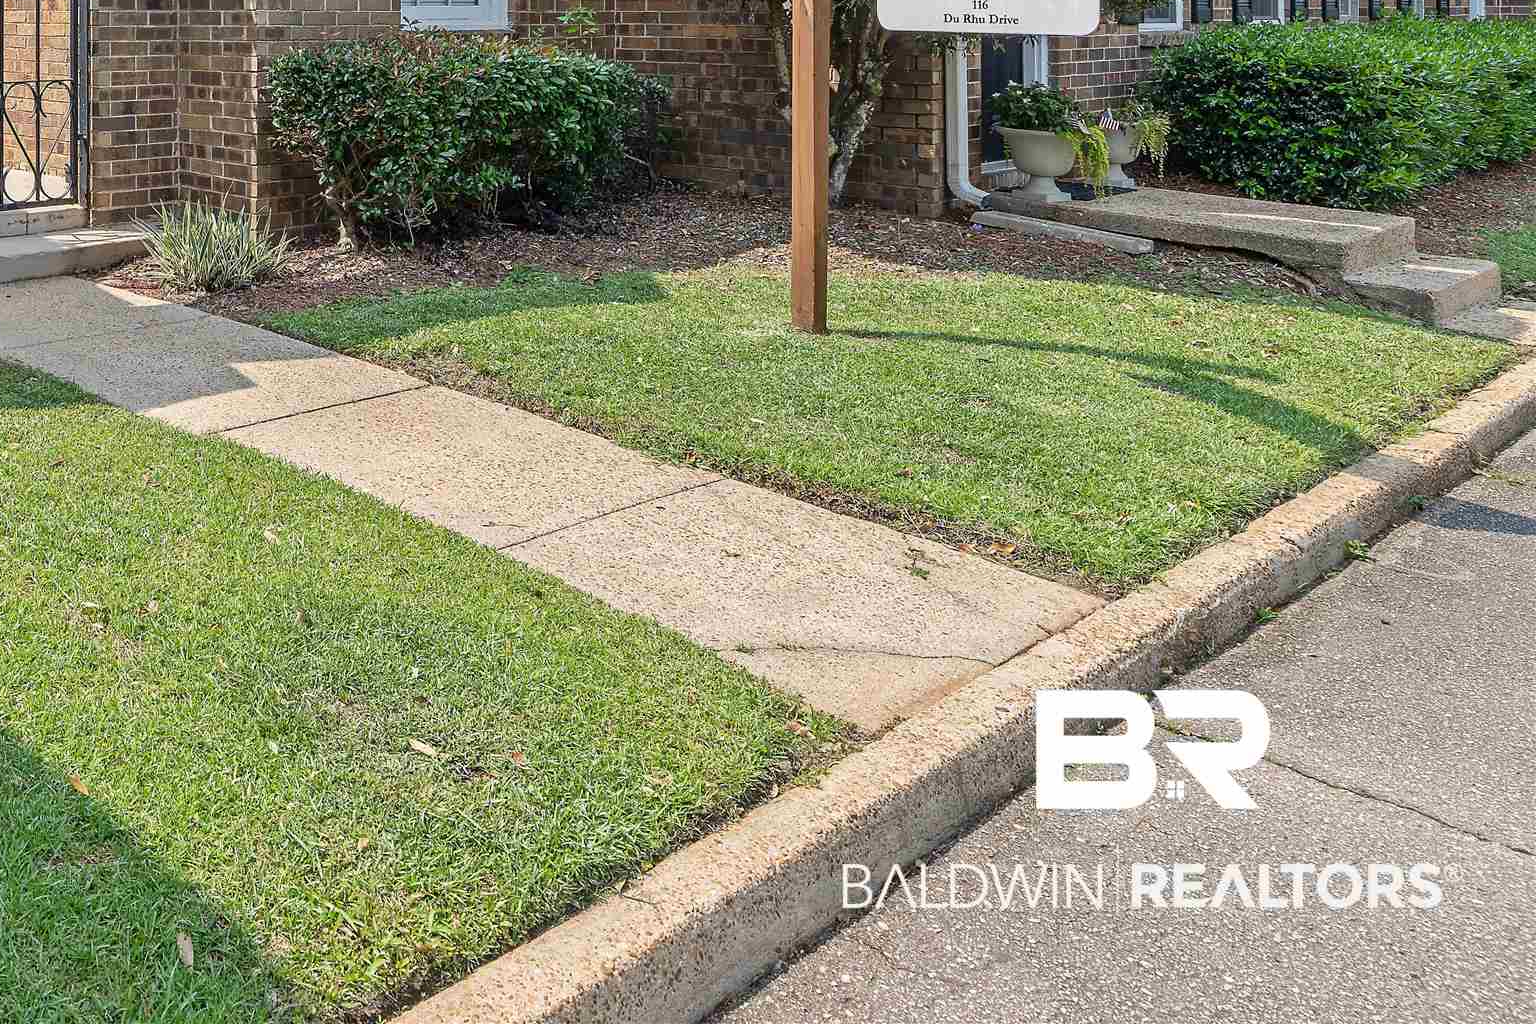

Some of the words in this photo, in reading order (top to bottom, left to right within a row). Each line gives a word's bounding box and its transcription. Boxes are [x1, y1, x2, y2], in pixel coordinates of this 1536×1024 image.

[971, 0, 989, 10] 116
[943, 13, 960, 24] Du
[963, 13, 986, 25] Rhu
[988, 13, 1020, 25] Drive
